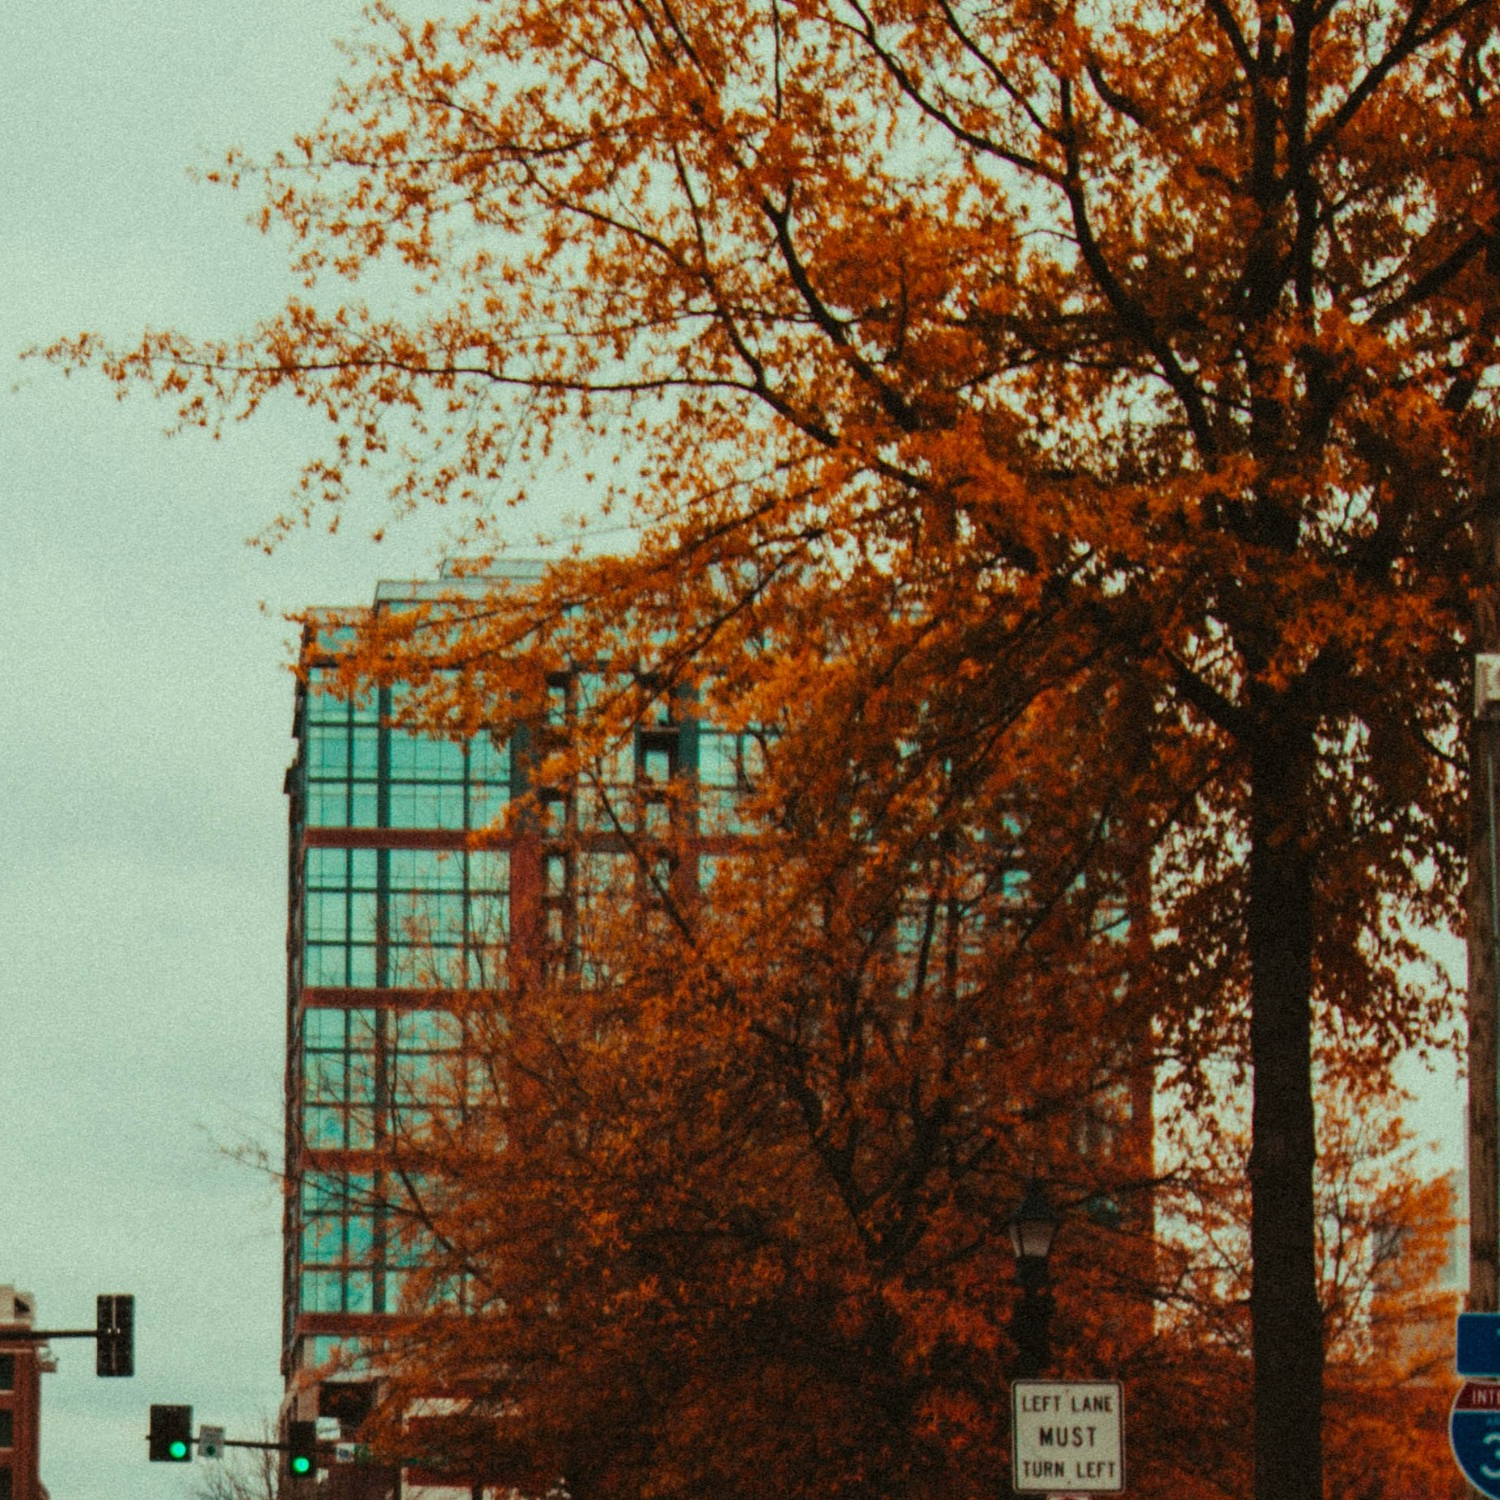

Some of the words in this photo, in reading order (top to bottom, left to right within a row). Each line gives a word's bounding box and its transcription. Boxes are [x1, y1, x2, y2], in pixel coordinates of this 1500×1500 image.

[1022, 1396, 1061, 1413] LEFT
[1071, 1396, 1113, 1413] LANE
[1039, 1426, 1097, 1447] MUST
[1023, 1461, 1065, 1478] TURN
[1077, 1461, 1116, 1479] LEFT
